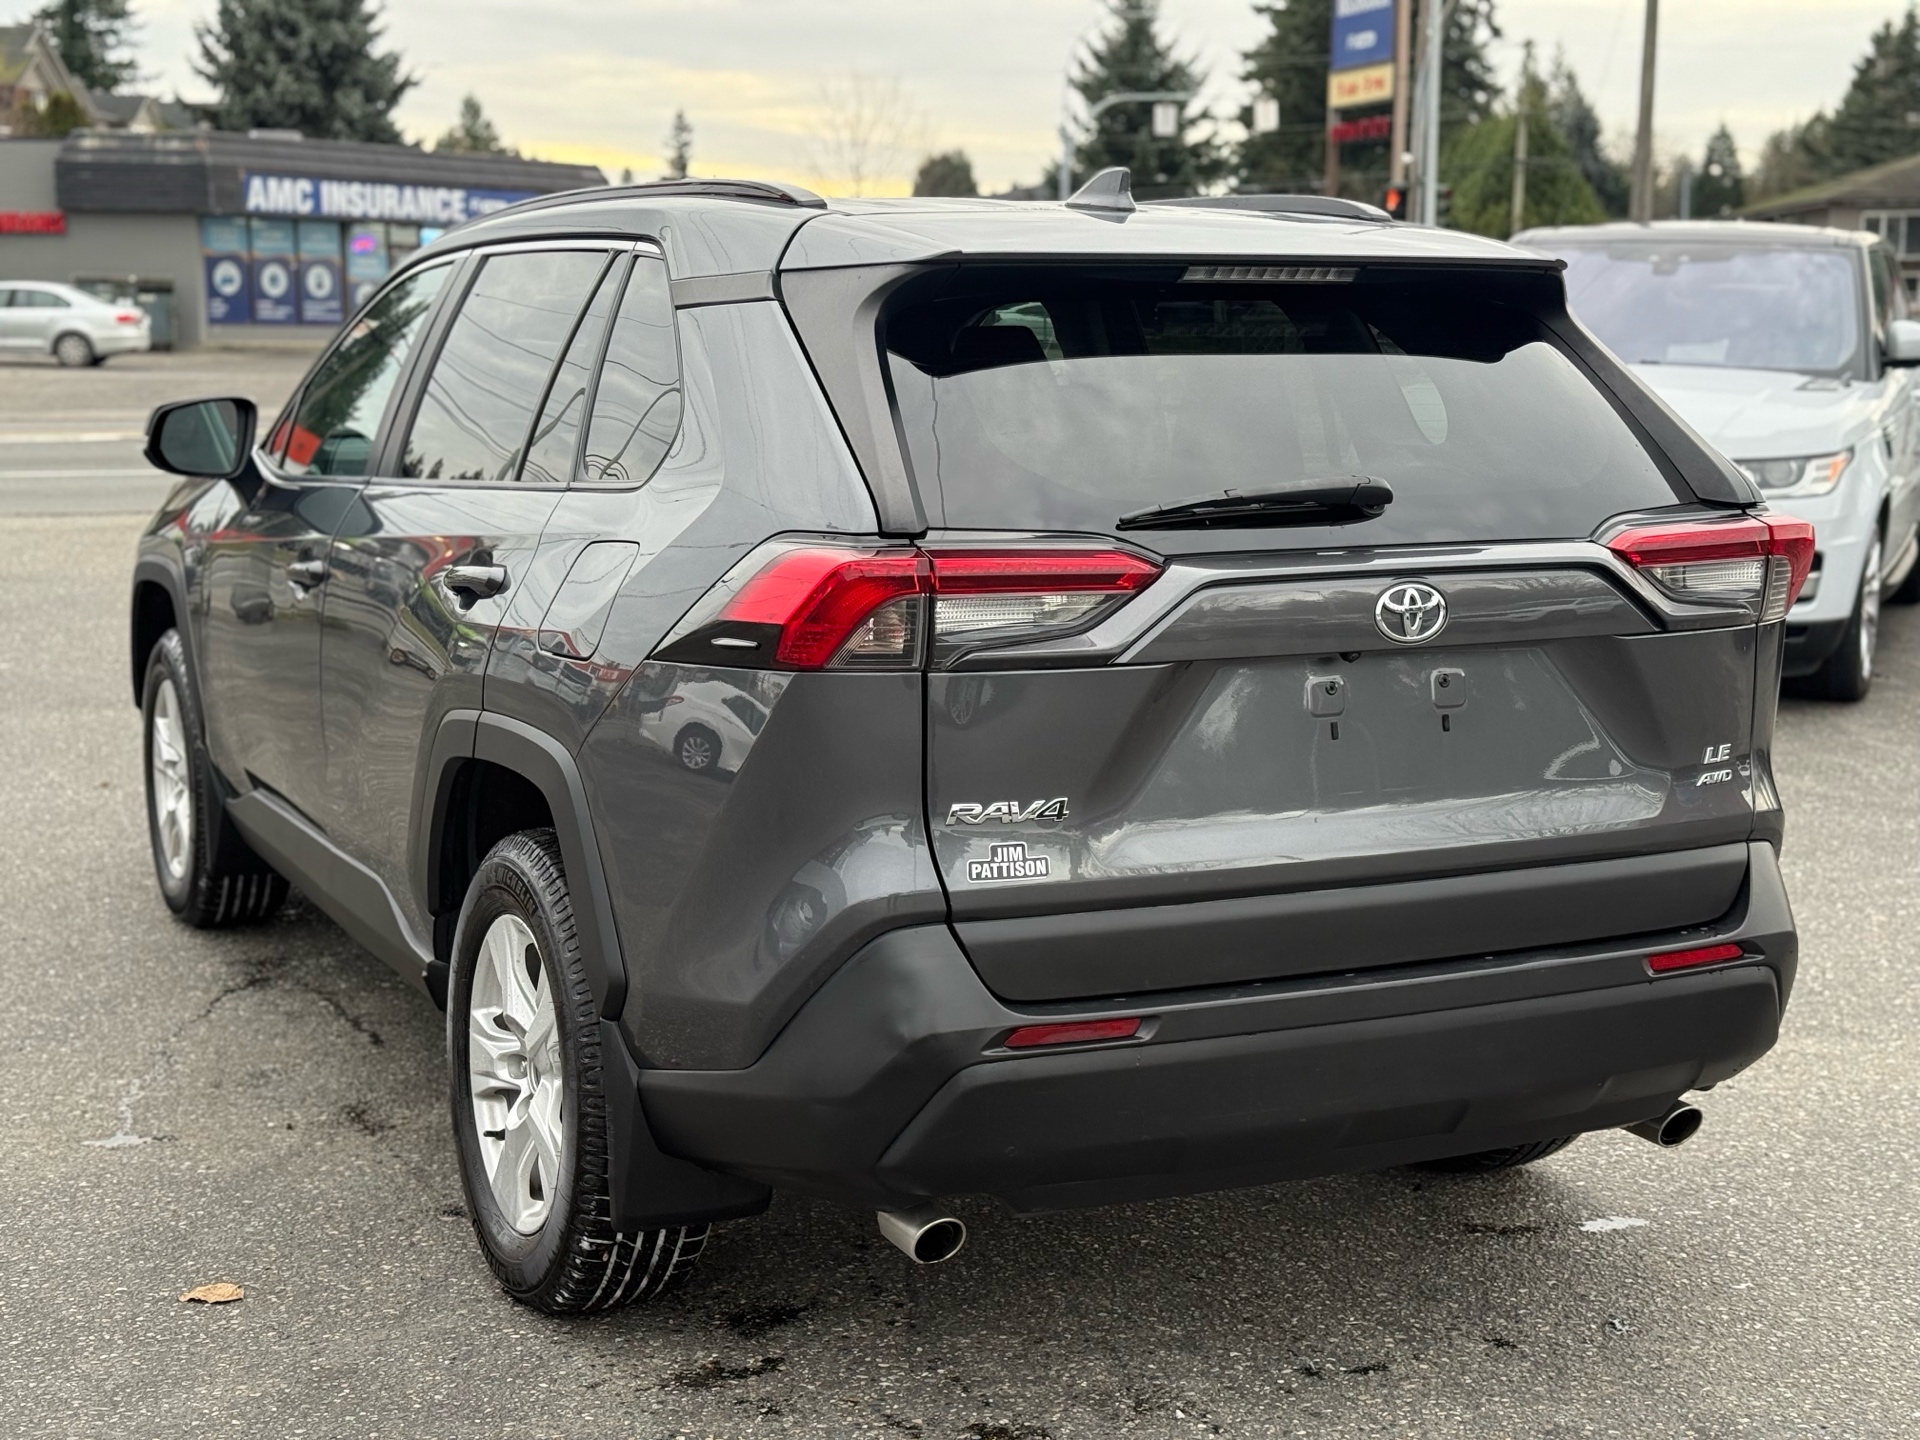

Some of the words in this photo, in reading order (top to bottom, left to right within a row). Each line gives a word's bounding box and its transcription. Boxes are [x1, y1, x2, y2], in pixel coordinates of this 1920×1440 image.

[246, 175, 315, 214] AMC
[319, 180, 468, 222] INSURANCE
[1703, 743, 1731, 764] LE
[945, 797, 1069, 825] RAV4
[993, 846, 1023, 863] JIM
[971, 860, 1047, 879] PATTISON
[497, 868, 535, 913] MICHELIN
